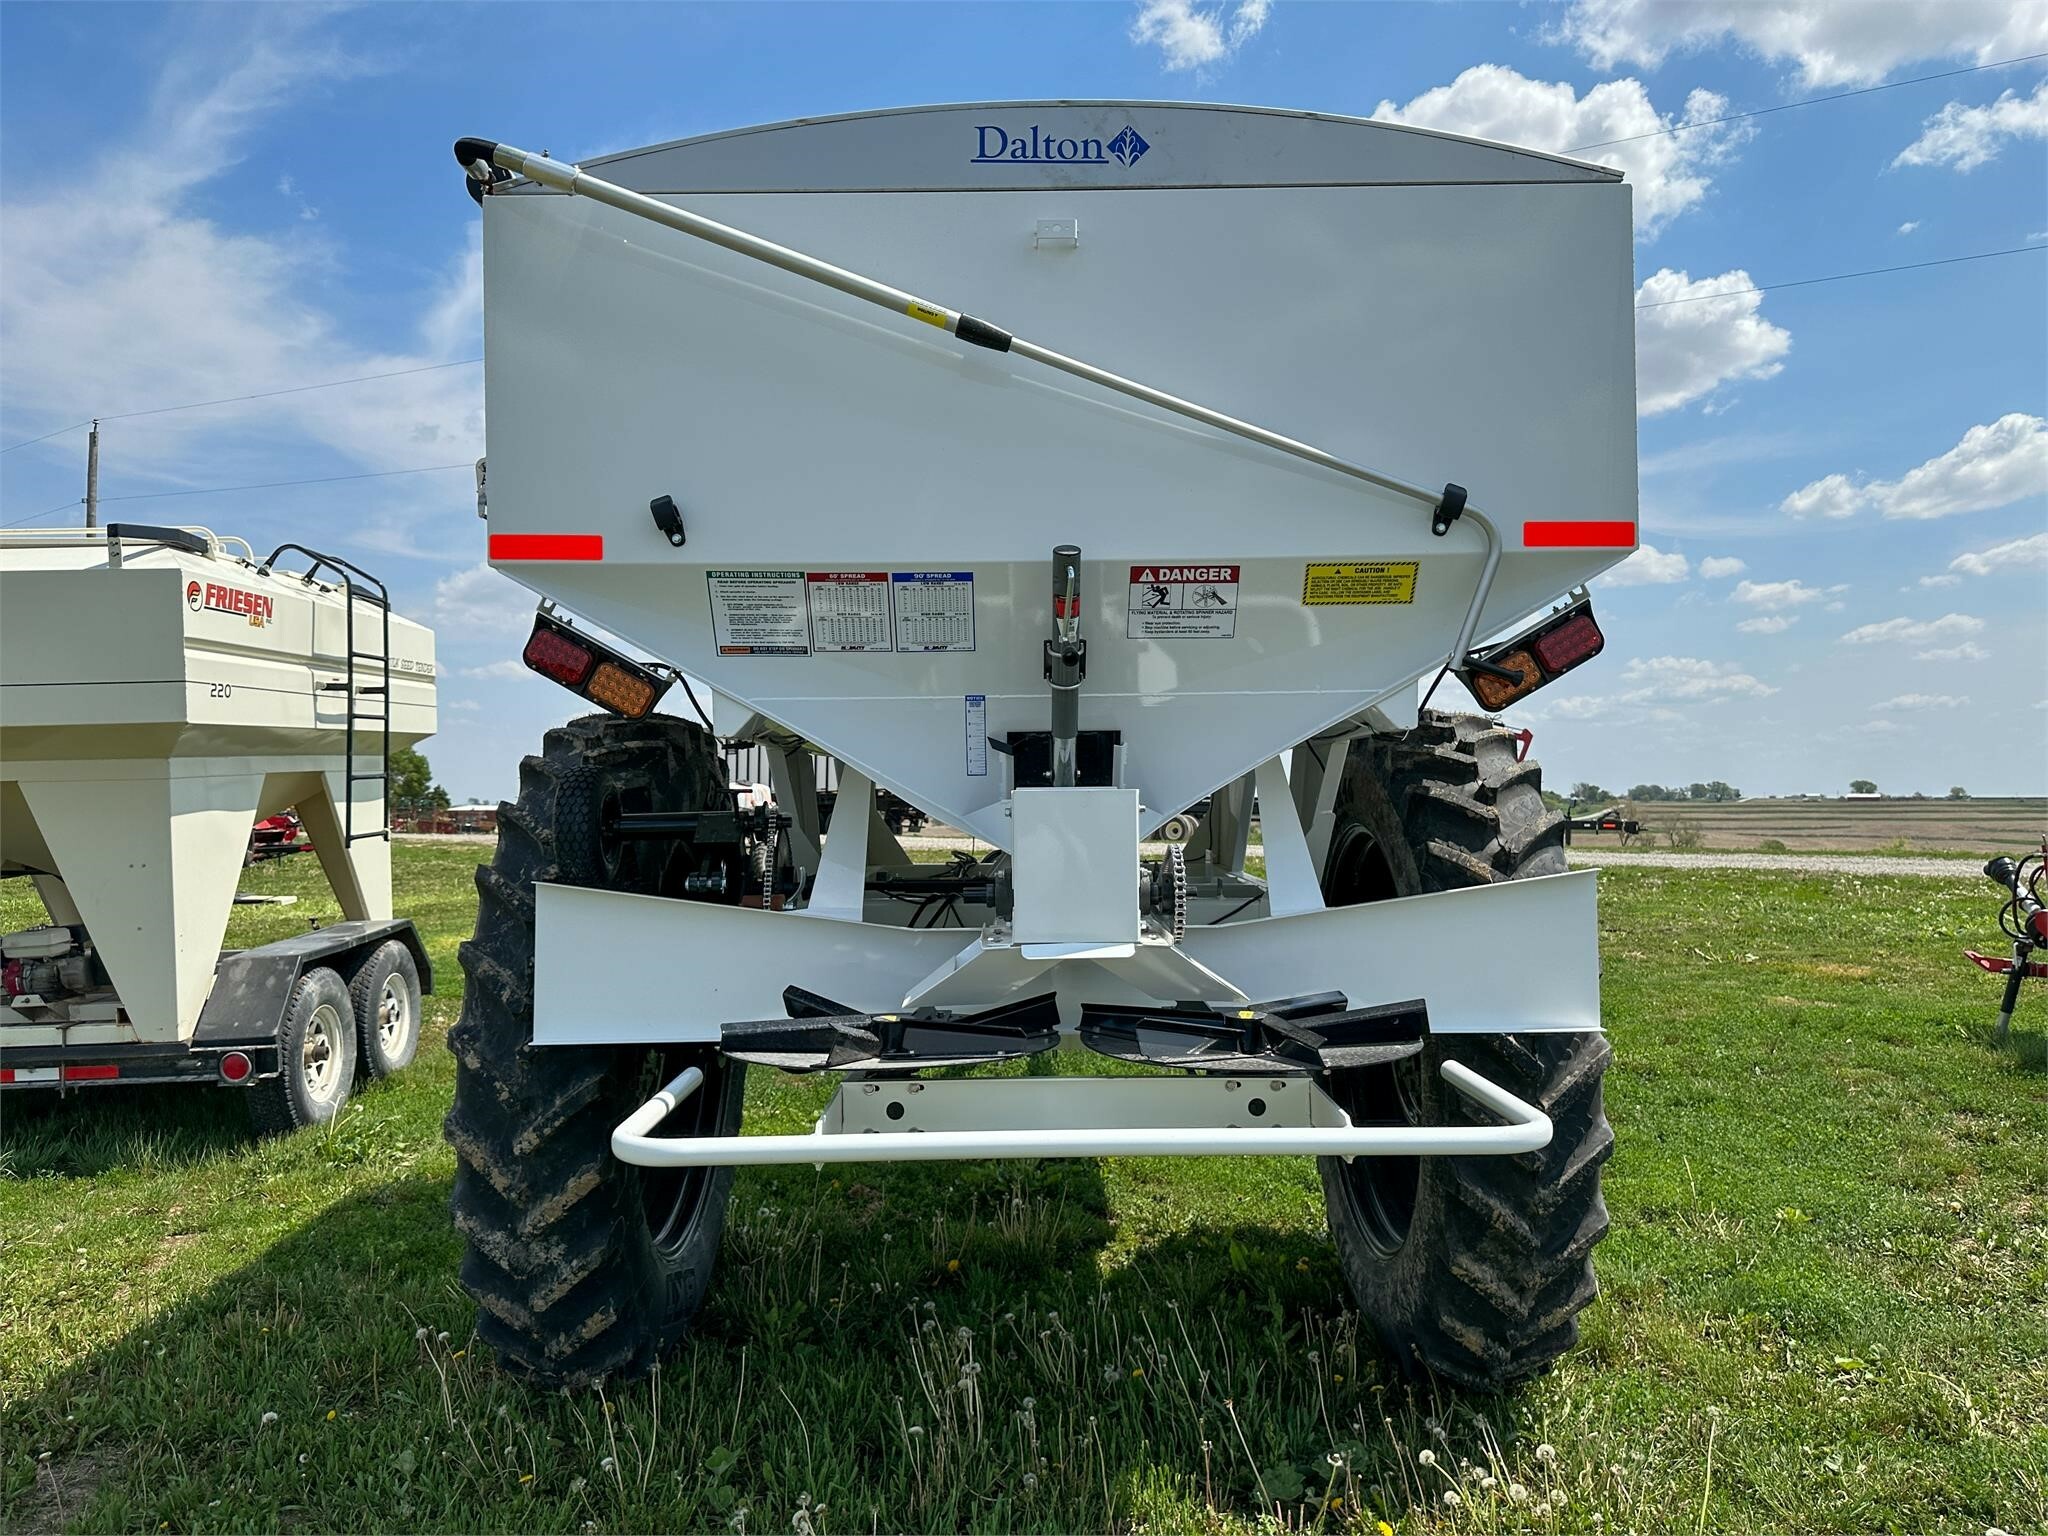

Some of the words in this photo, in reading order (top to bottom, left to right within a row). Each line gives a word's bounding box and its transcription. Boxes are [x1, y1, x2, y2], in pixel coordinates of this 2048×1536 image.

[974, 125, 1106, 160] Dalton
[1159, 568, 1231, 581] DANGER
[205, 583, 274, 619] FRIESEN
[210, 683, 232, 698] 220
